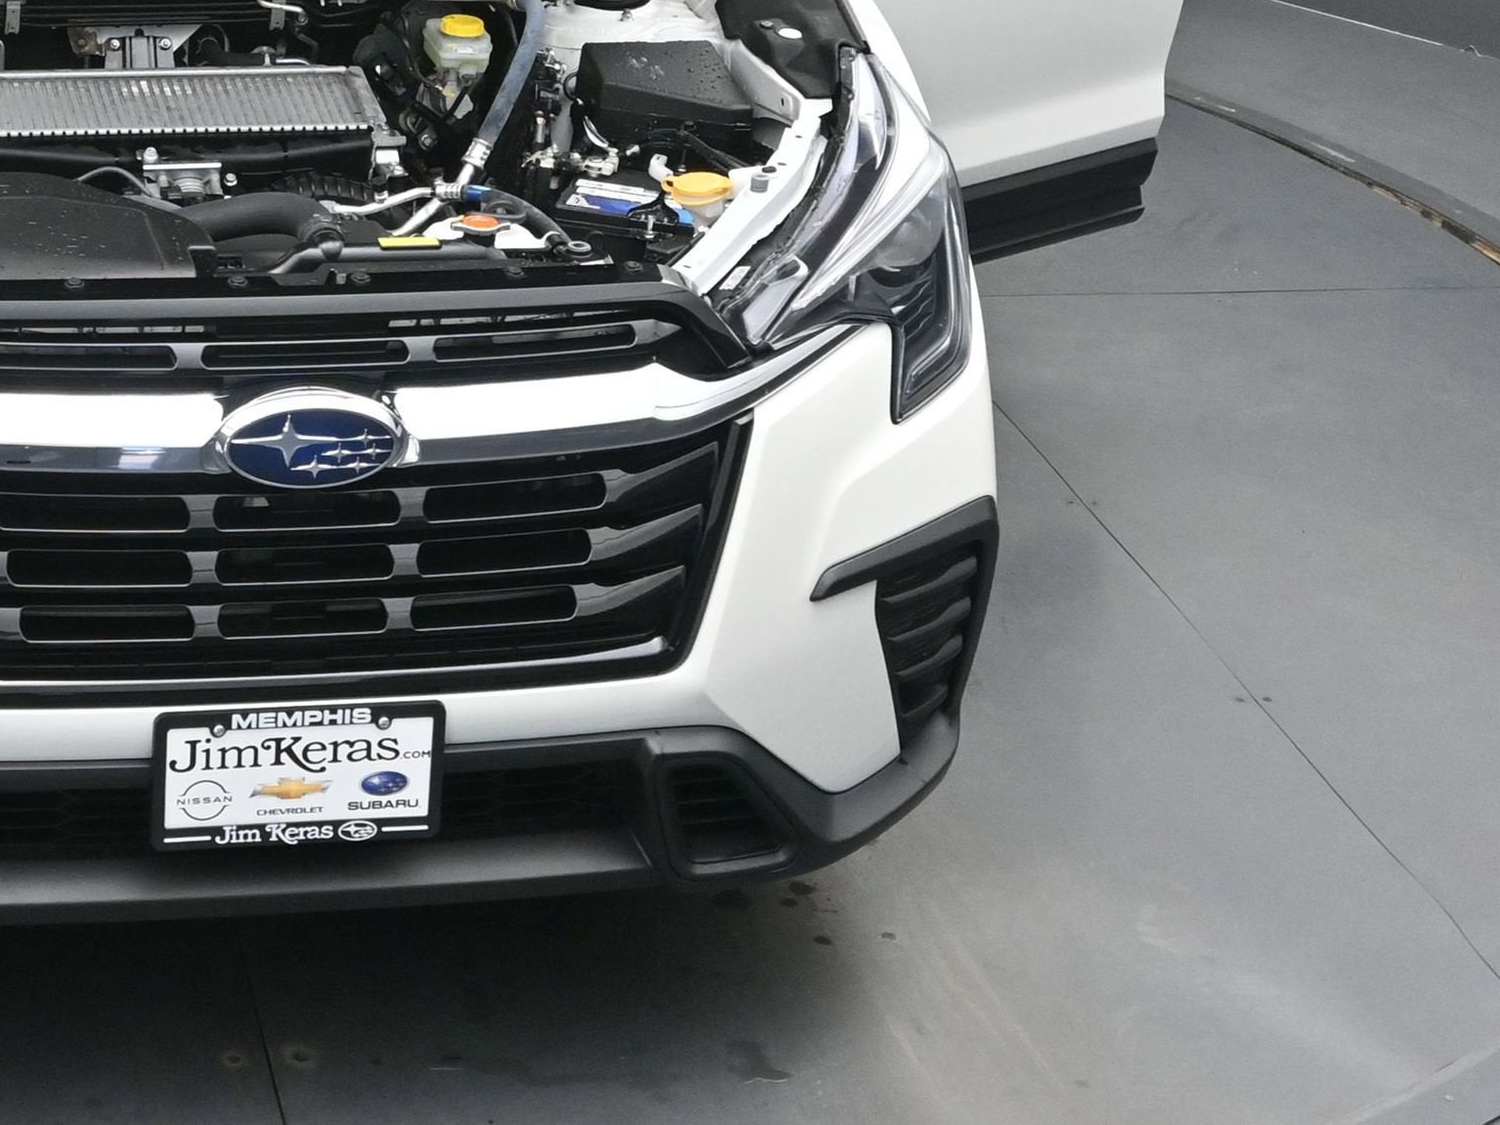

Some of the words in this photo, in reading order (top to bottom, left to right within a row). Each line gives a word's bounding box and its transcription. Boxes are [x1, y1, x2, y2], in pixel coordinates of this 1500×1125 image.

[231, 708, 371, 729] MEMPHIS
[177, 795, 232, 805] NISSAN
[348, 799, 419, 811] SUBARU
[256, 806, 324, 816] CHEVROLET
[215, 825, 261, 844] Jim
[265, 824, 334, 845] Keras
